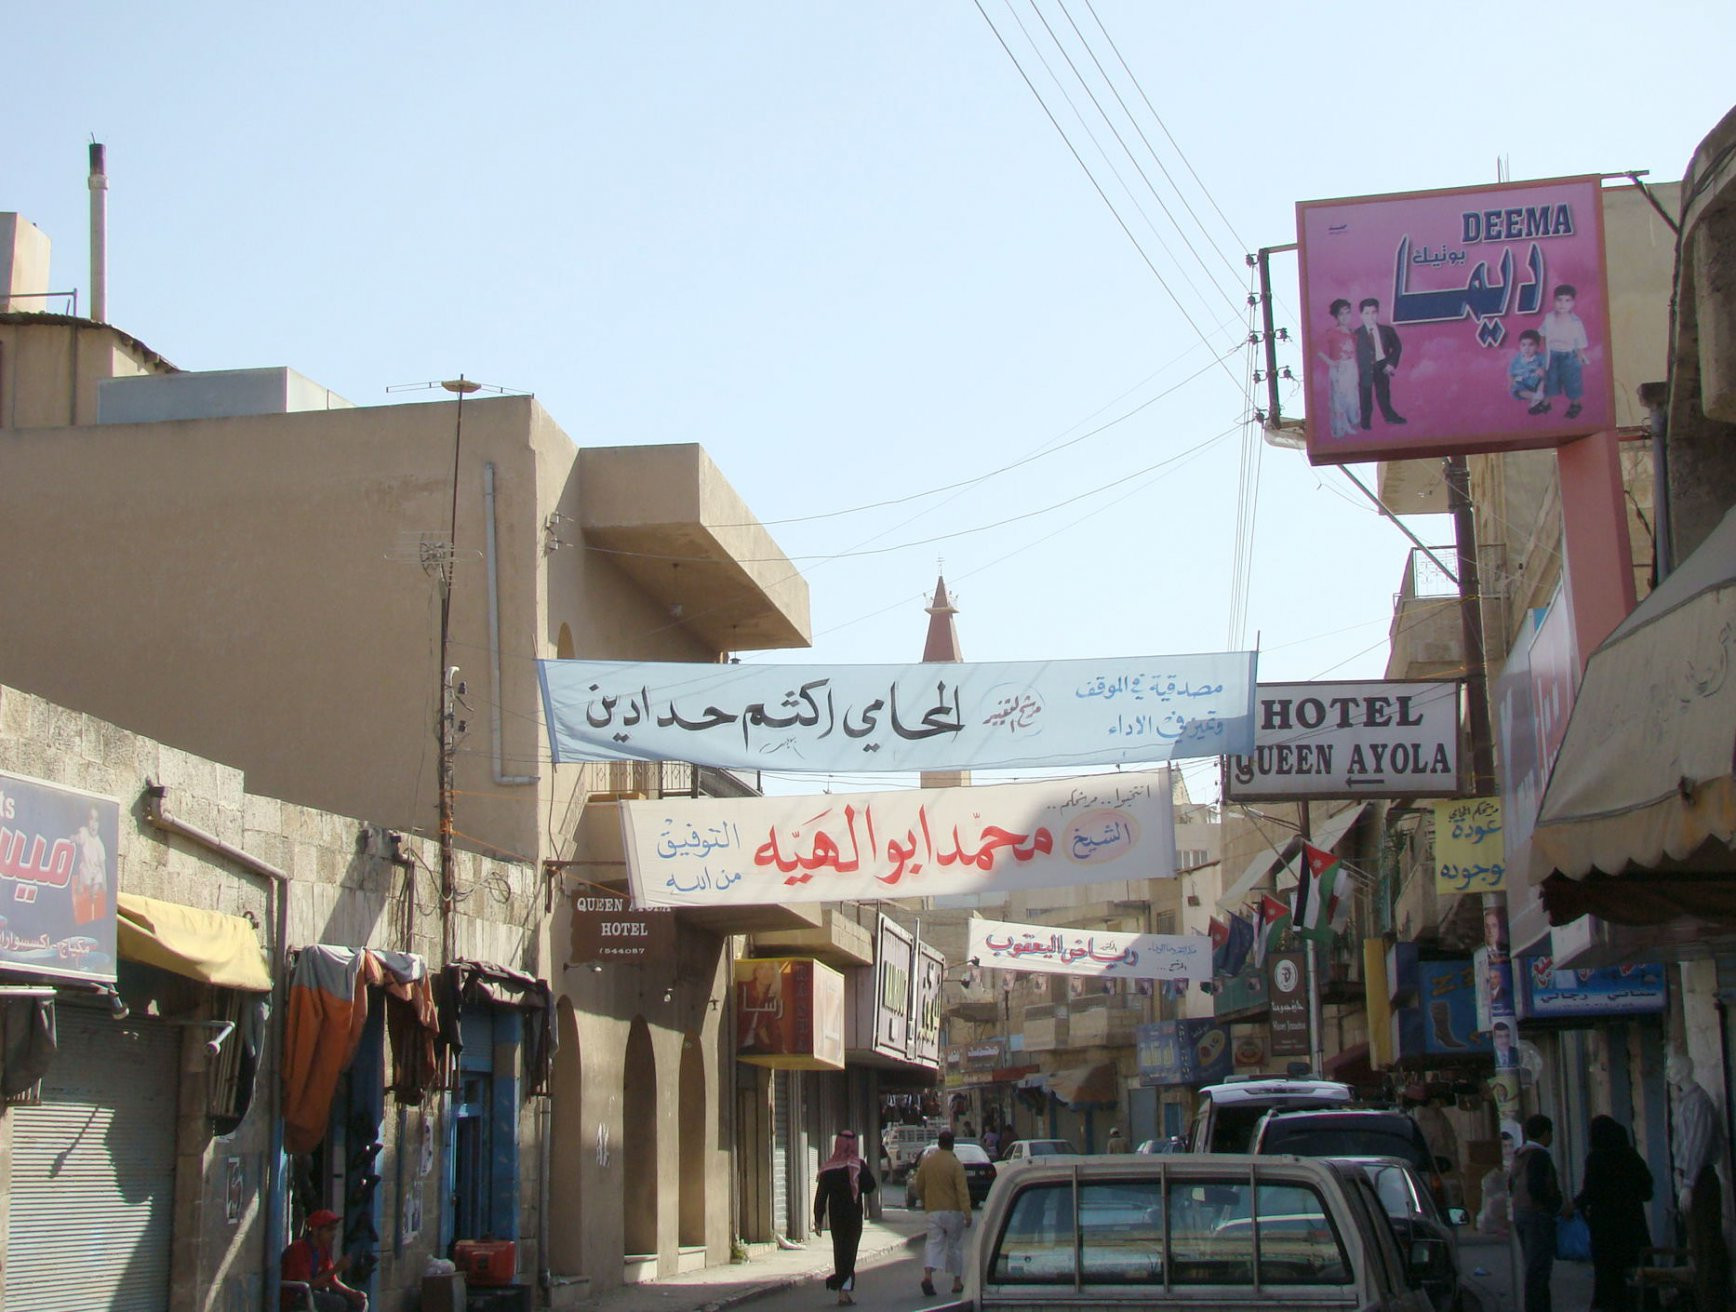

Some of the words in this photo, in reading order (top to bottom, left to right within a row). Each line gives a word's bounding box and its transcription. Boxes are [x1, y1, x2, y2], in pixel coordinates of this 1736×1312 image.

[1462, 203, 1574, 243] DEEMA
[1391, 234, 1545, 348] ديما
[1075, 675, 1128, 699] الموقف
[1130, 673, 1145, 700] في
[586, 683, 739, 744] حدادين
[843, 679, 965, 752] المحامي
[1261, 696, 1424, 730] HOTEL
[1234, 744, 1334, 785] QUEEN
[1347, 743, 1451, 774] AYOLA
[657, 818, 741, 859] التوفيق
[1072, 821, 1131, 859] الشيخ
[665, 866, 712, 892] الله
[715, 868, 742, 891] من
[576, 897, 623, 912] QUEEN
[0, 930, 50, 950] اكسسوارا
[601, 922, 648, 936] HOTEL
[985, 932, 1063, 960] اليعقوب
[1060, 936, 1139, 970] رياض
